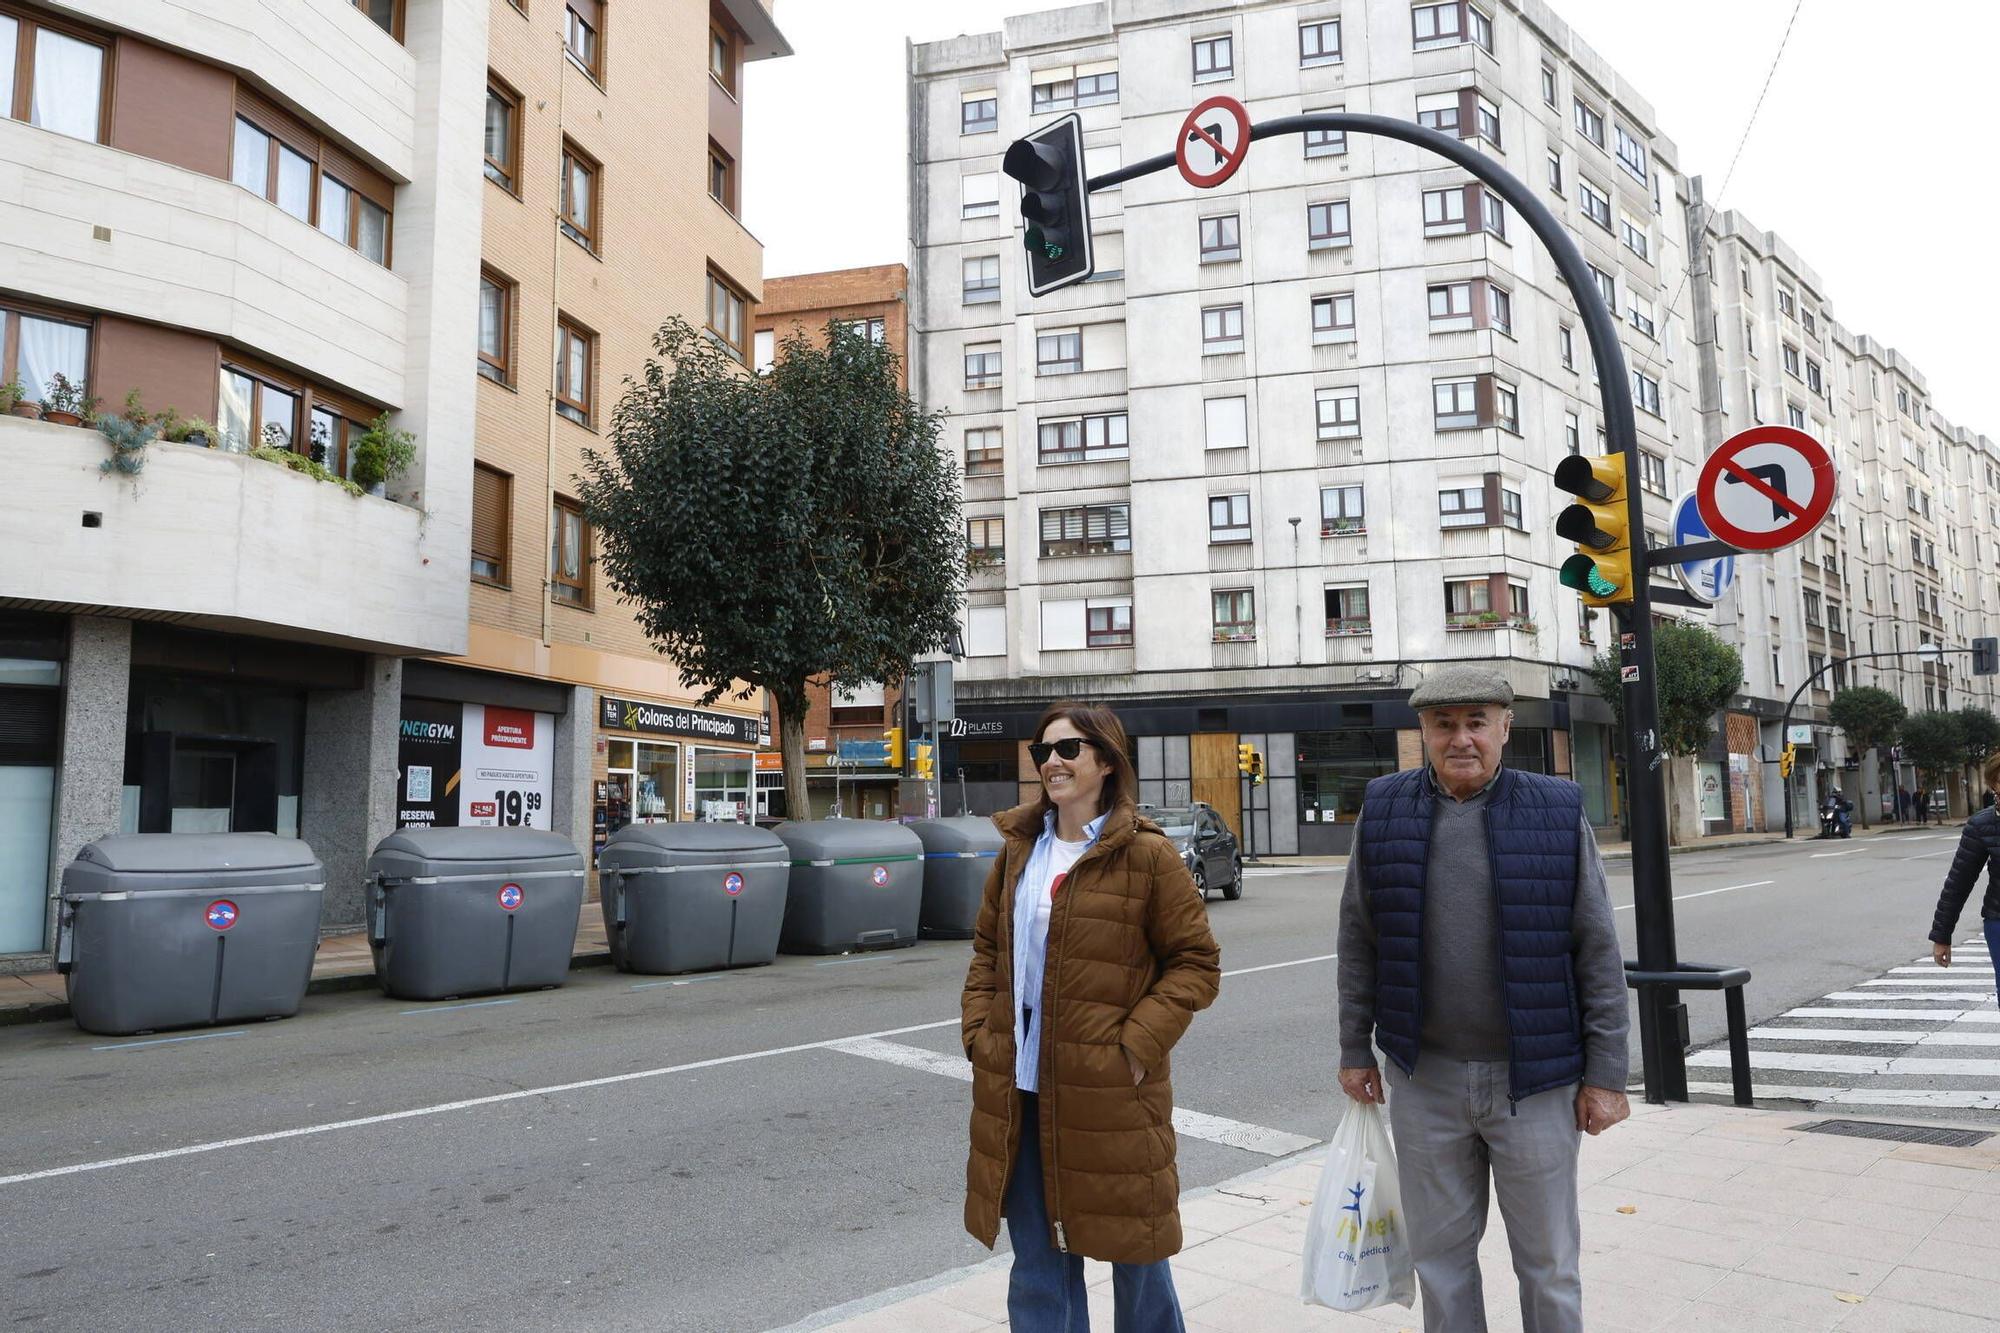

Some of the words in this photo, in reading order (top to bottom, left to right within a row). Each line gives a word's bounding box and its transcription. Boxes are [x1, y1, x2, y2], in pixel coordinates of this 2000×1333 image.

[638, 706, 674, 728] Colores
[676, 712, 690, 730] del
[692, 714, 736, 737] Principado
[968, 721, 1003, 731] PILATES
[400, 810, 435, 821] RESERVA
